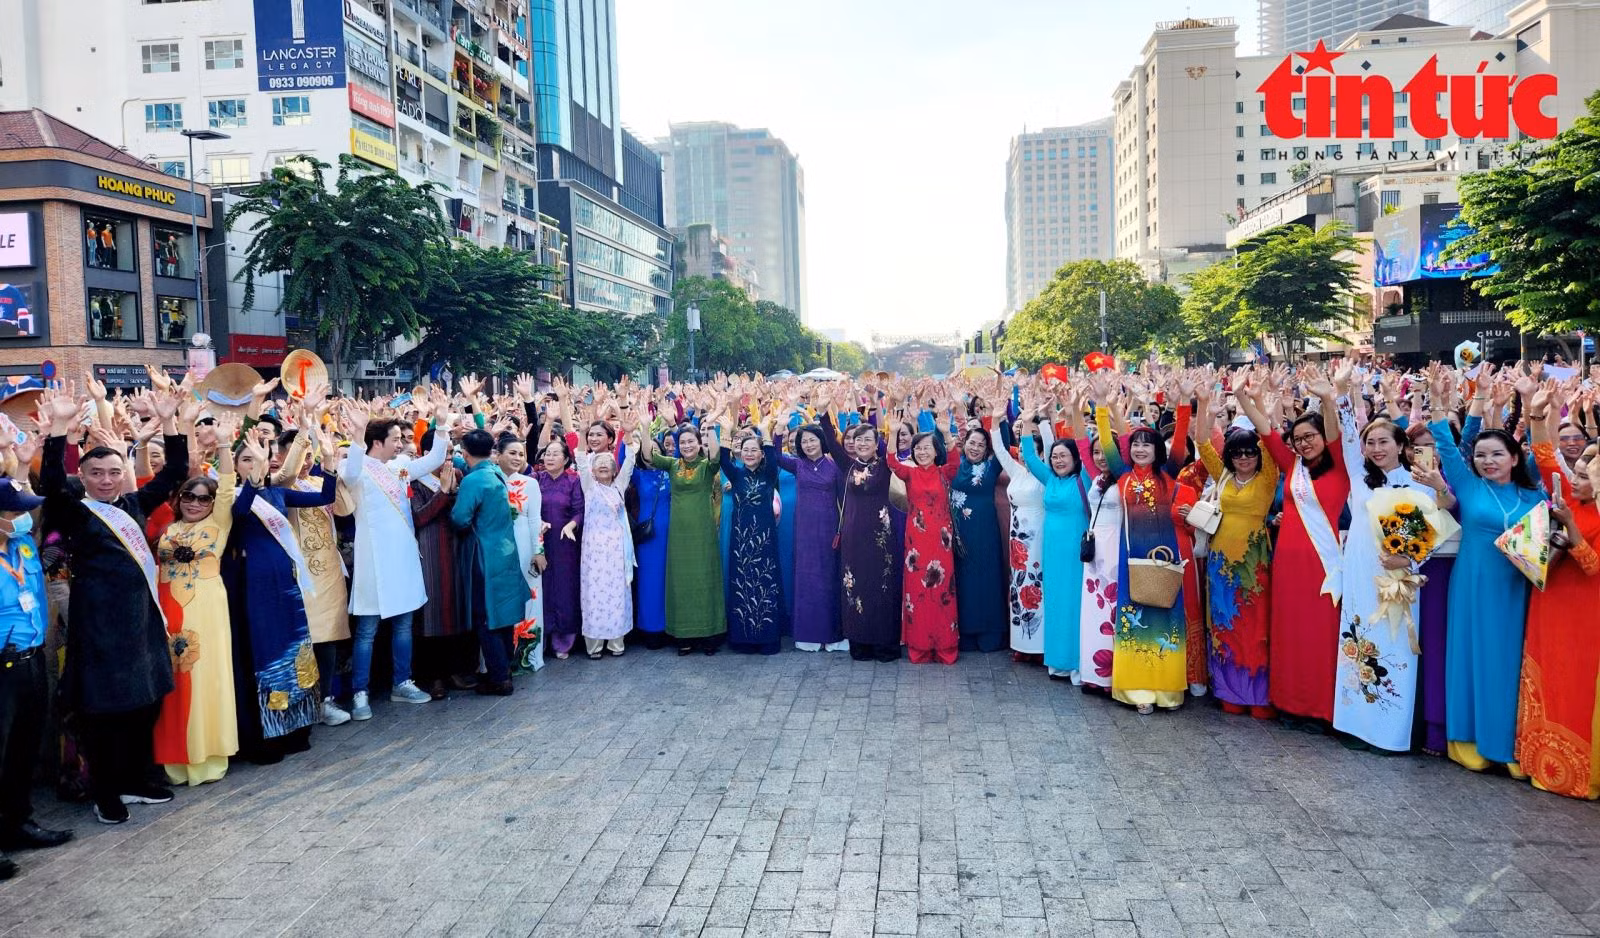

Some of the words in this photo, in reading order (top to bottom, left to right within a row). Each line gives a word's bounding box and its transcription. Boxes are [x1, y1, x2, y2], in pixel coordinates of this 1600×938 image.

[263, 46, 336, 61] LANCASTER
[362, 48, 388, 71] TRUNG
[268, 61, 332, 71] LEGACY
[269, 77, 294, 88] 0933
[297, 75, 334, 87] 090909
[98, 175, 142, 198] HOANG
[144, 186, 176, 205] PHUC
